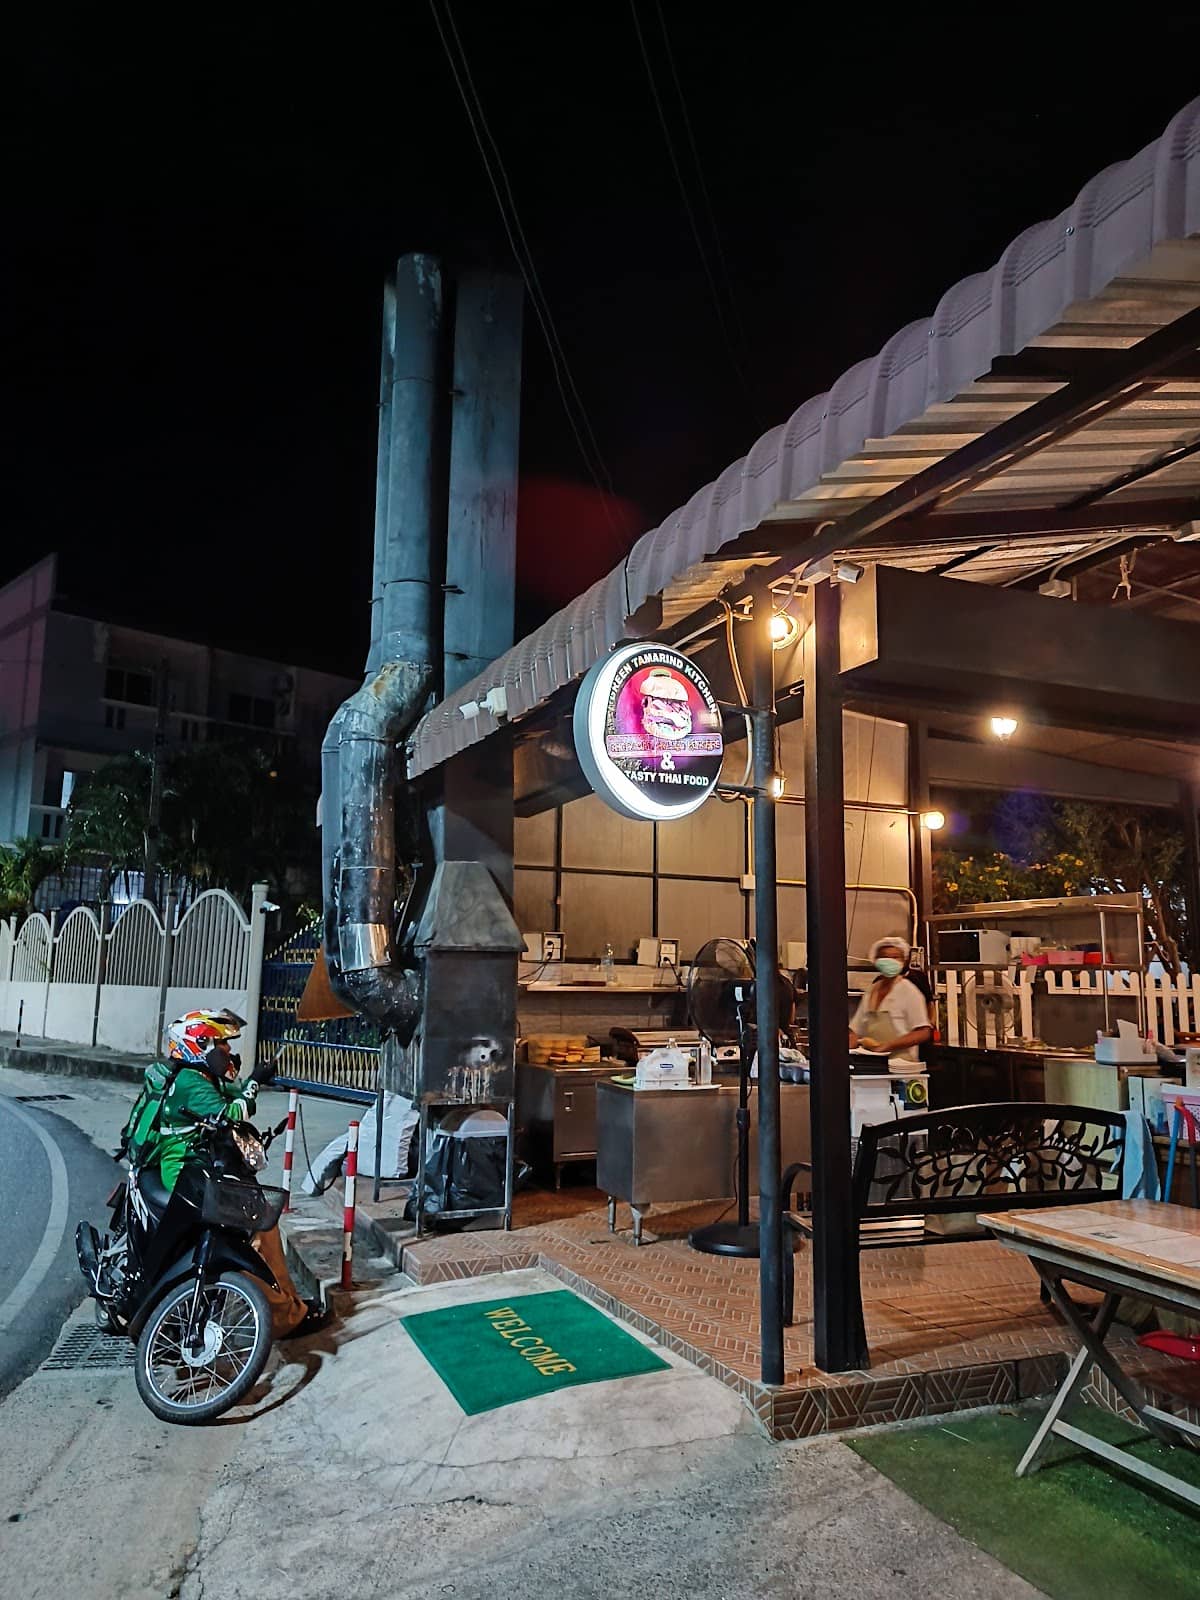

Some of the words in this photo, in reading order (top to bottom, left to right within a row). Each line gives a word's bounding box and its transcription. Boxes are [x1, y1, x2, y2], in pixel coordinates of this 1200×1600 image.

[631, 652, 684, 669] TAMARIND
[684, 665, 717, 713] KITCHEN
[624, 770, 657, 782] TASTY
[658, 773, 682, 785] THAI
[683, 775, 709, 786] FOOD
[660, 752, 676, 770] &
[483, 1306, 578, 1376] WELCOME
